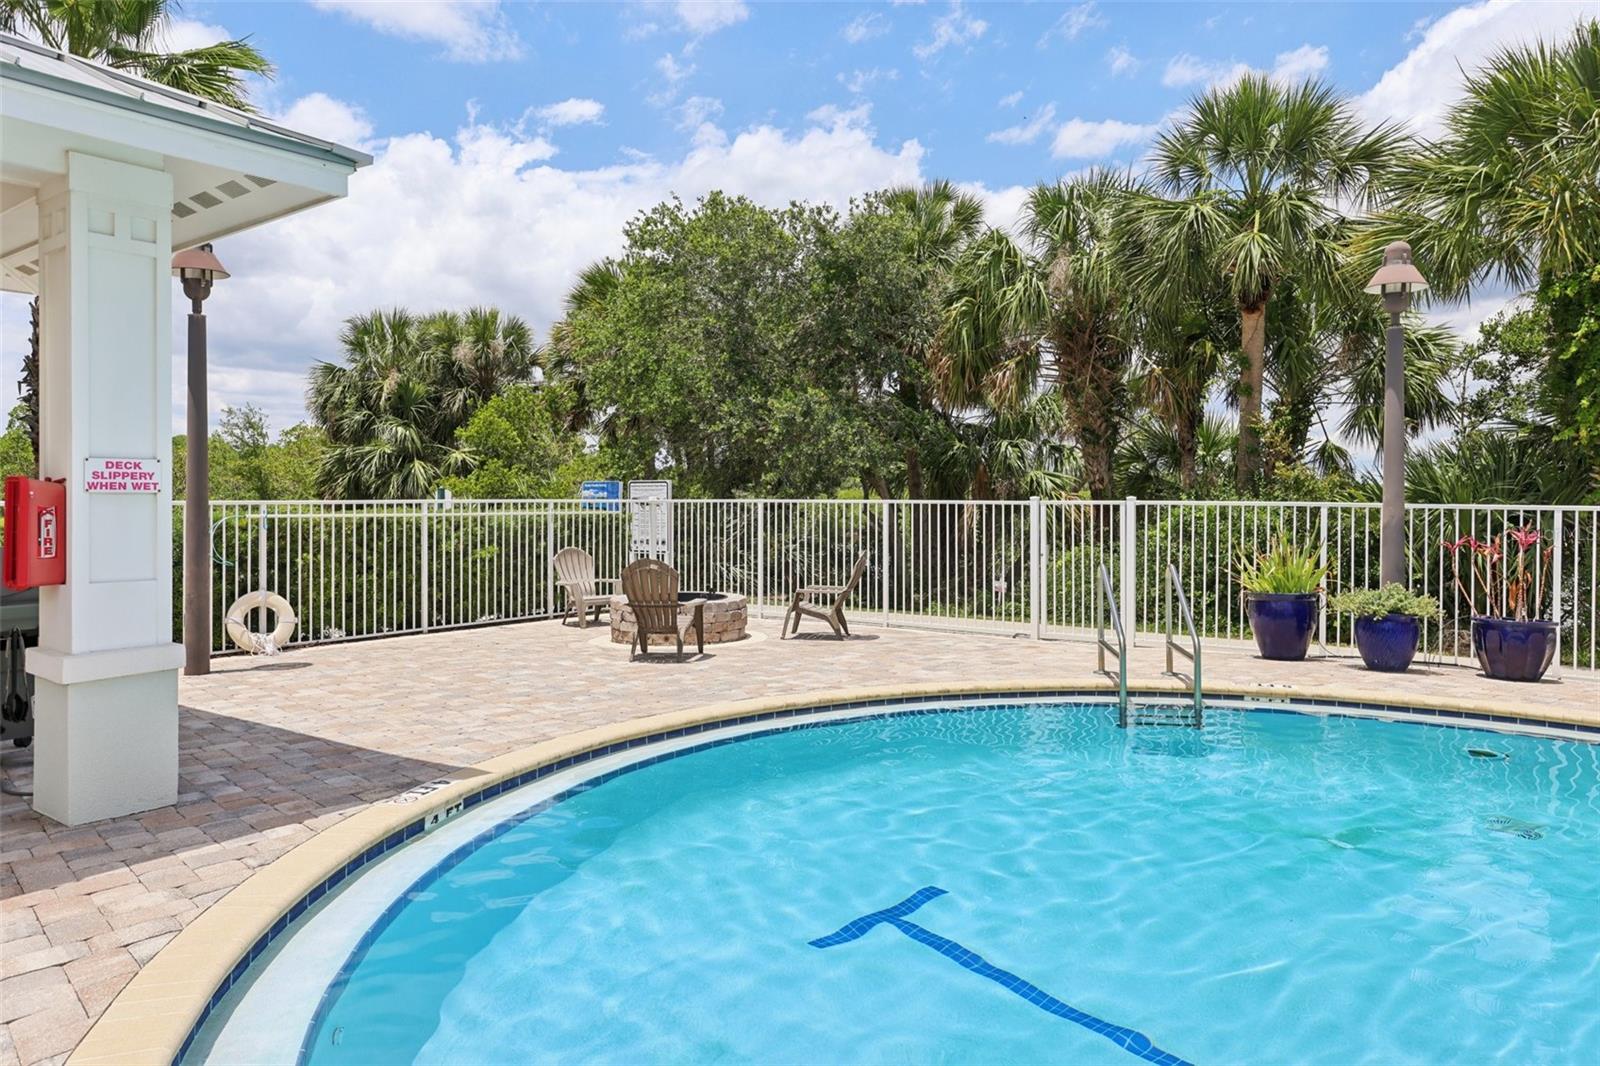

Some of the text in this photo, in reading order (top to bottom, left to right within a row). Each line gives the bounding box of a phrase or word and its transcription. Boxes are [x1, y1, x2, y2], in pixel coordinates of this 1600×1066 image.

[105, 461, 142, 470] DECK
[91, 471, 155, 480] SLIPPERY
[87, 481, 160, 491] WHEN WET
[44, 519, 53, 556] FIRE
[430, 802, 462, 825] 4 FT
